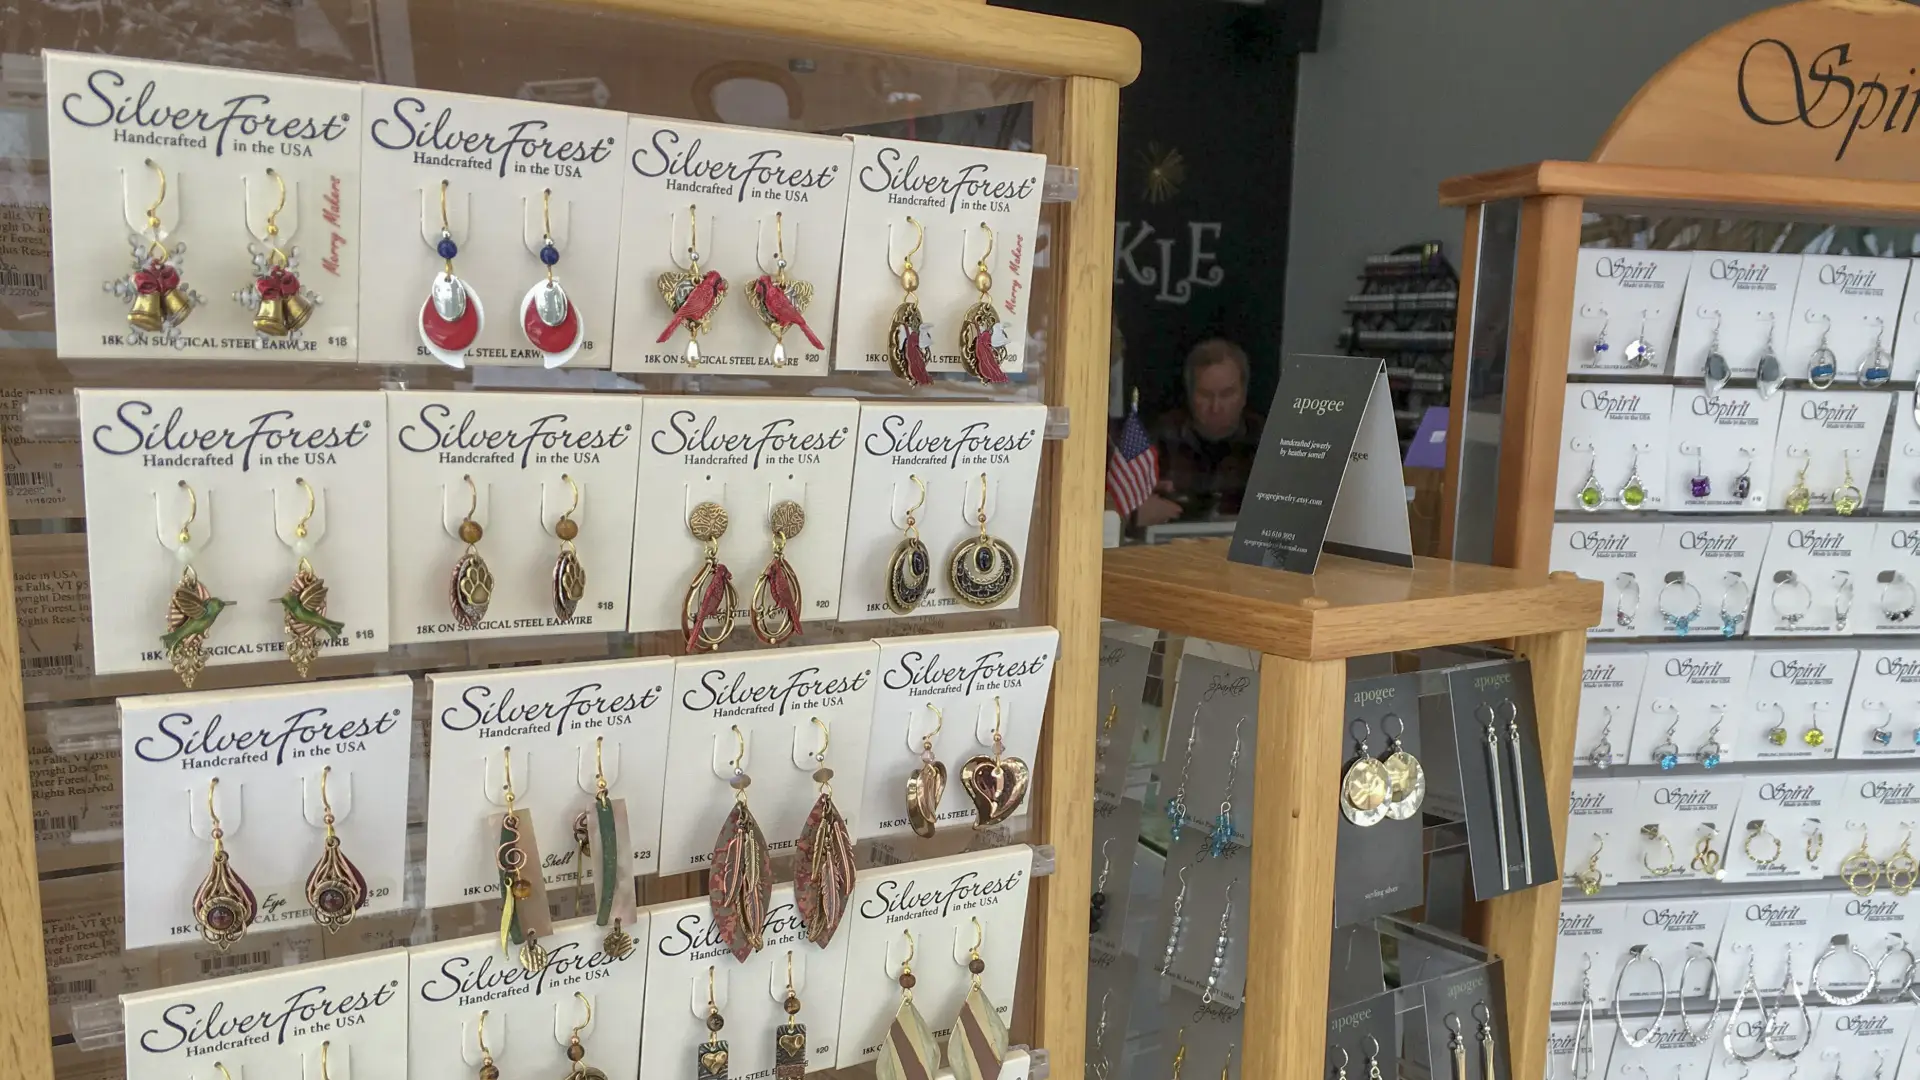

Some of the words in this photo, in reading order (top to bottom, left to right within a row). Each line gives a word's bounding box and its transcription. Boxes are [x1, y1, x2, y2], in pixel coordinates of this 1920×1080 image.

[113, 129, 207, 148] Handcrafted
[233, 140, 247, 152] in
[251, 140, 275, 154] the
[280, 142, 313, 157] USA
[413, 151, 492, 170] Handcrafted
[514, 160, 526, 173] in
[530, 162, 550, 175] the
[554, 164, 582, 178] USA
[666, 178, 733, 196] Handcrafted
[751, 187, 761, 198] in
[763, 188, 781, 200] the
[785, 190, 809, 202] USA
[888, 194, 945, 208] Handcrafted
[961, 199, 970, 209] in
[970, 200, 987, 211] the
[989, 202, 1011, 213] USA
[1596, 256, 1657, 286] Spirit
[1710, 258, 1770, 288] Spirit
[1819, 264, 1877, 293] Spirit
[101, 335, 124, 346] 18K
[476, 348, 509, 358] STEEL
[644, 354, 661, 364] 18K
[663, 355, 678, 364] ON
[729, 356, 757, 366] STEEL
[805, 353, 820, 362] $20
[1293, 396, 1344, 415] apogee
[1581, 389, 1640, 419] Spirit
[1692, 395, 1751, 424] Spirit
[1801, 400, 1859, 428] Spirit
[143, 454, 234, 467] Handcrafted
[259, 455, 273, 465] in
[277, 454, 300, 465] the
[304, 453, 337, 465] USA
[439, 452, 515, 464] Handcrafted
[535, 453, 547, 463] in
[551, 452, 569, 463] the
[574, 452, 600, 463] USA
[684, 454, 748, 465] Handcrafted
[766, 455, 774, 464] in
[776, 454, 794, 465] the
[798, 454, 820, 464] USA
[892, 455, 947, 465] Handcrafted
[962, 455, 970, 464] in
[971, 454, 987, 464] the
[989, 454, 1010, 464] USA
[1570, 530, 1630, 556] Spirit
[1680, 530, 1738, 556] Spirit
[1788, 530, 1845, 555] Spirit
[598, 601, 614, 610] $18
[355, 629, 375, 640] $18
[416, 625, 435, 634] 18K
[438, 622, 455, 633] ON
[513, 617, 545, 628] STEEL
[140, 650, 163, 662] 18K
[1665, 657, 1723, 683] Spirit
[1770, 660, 1827, 684] Spirit
[909, 683, 962, 697] Handcrafted
[976, 681, 984, 691] in
[986, 679, 1000, 690] the
[1003, 678, 1023, 689] USA
[1474, 672, 1512, 692] apogee
[1354, 685, 1396, 704] apogee
[713, 703, 775, 718] Handcrafted
[791, 700, 800, 711] in
[803, 699, 819, 710] the
[822, 696, 844, 707] USA
[479, 722, 551, 738] Handcrafted
[571, 719, 581, 729] in
[585, 718, 603, 728] the
[607, 715, 632, 726] USA
[181, 751, 269, 770] Handcrafted
[293, 747, 305, 758] in
[309, 745, 331, 756] the
[336, 741, 366, 754] USA
[1654, 787, 1712, 810] Spirit
[1759, 783, 1815, 807] Spirit
[1860, 781, 1916, 804] Spirit
[879, 820, 893, 829] 18K
[894, 818, 907, 827] ON
[947, 810, 969, 820] STEEL
[768, 841, 793, 851] STEEL
[542, 850, 575, 869] Shell
[464, 885, 482, 896] 18K
[1385, 886, 1399, 896] silver
[262, 893, 287, 914] Eye
[886, 907, 939, 924] Handcrafted
[952, 903, 961, 912] in
[963, 901, 977, 911] the
[979, 896, 999, 907] USA
[1845, 899, 1900, 922] Spirit
[1643, 908, 1701, 932] Spirit
[1746, 904, 1801, 927] Spirit
[170, 923, 191, 935] 18K
[767, 938, 776, 946] in
[779, 935, 794, 944] the
[458, 984, 530, 1006] Handcrafted
[549, 979, 560, 989] in
[563, 976, 581, 986] the
[585, 969, 610, 981] USA
[1447, 975, 1484, 998] apogee
[1331, 1007, 1372, 1031] apogee
[1836, 1015, 1892, 1039] Spirit
[185, 1032, 270, 1057] Handcrafted
[293, 1026, 306, 1036] in
[310, 1021, 330, 1034] the
[336, 1014, 365, 1028] USA
